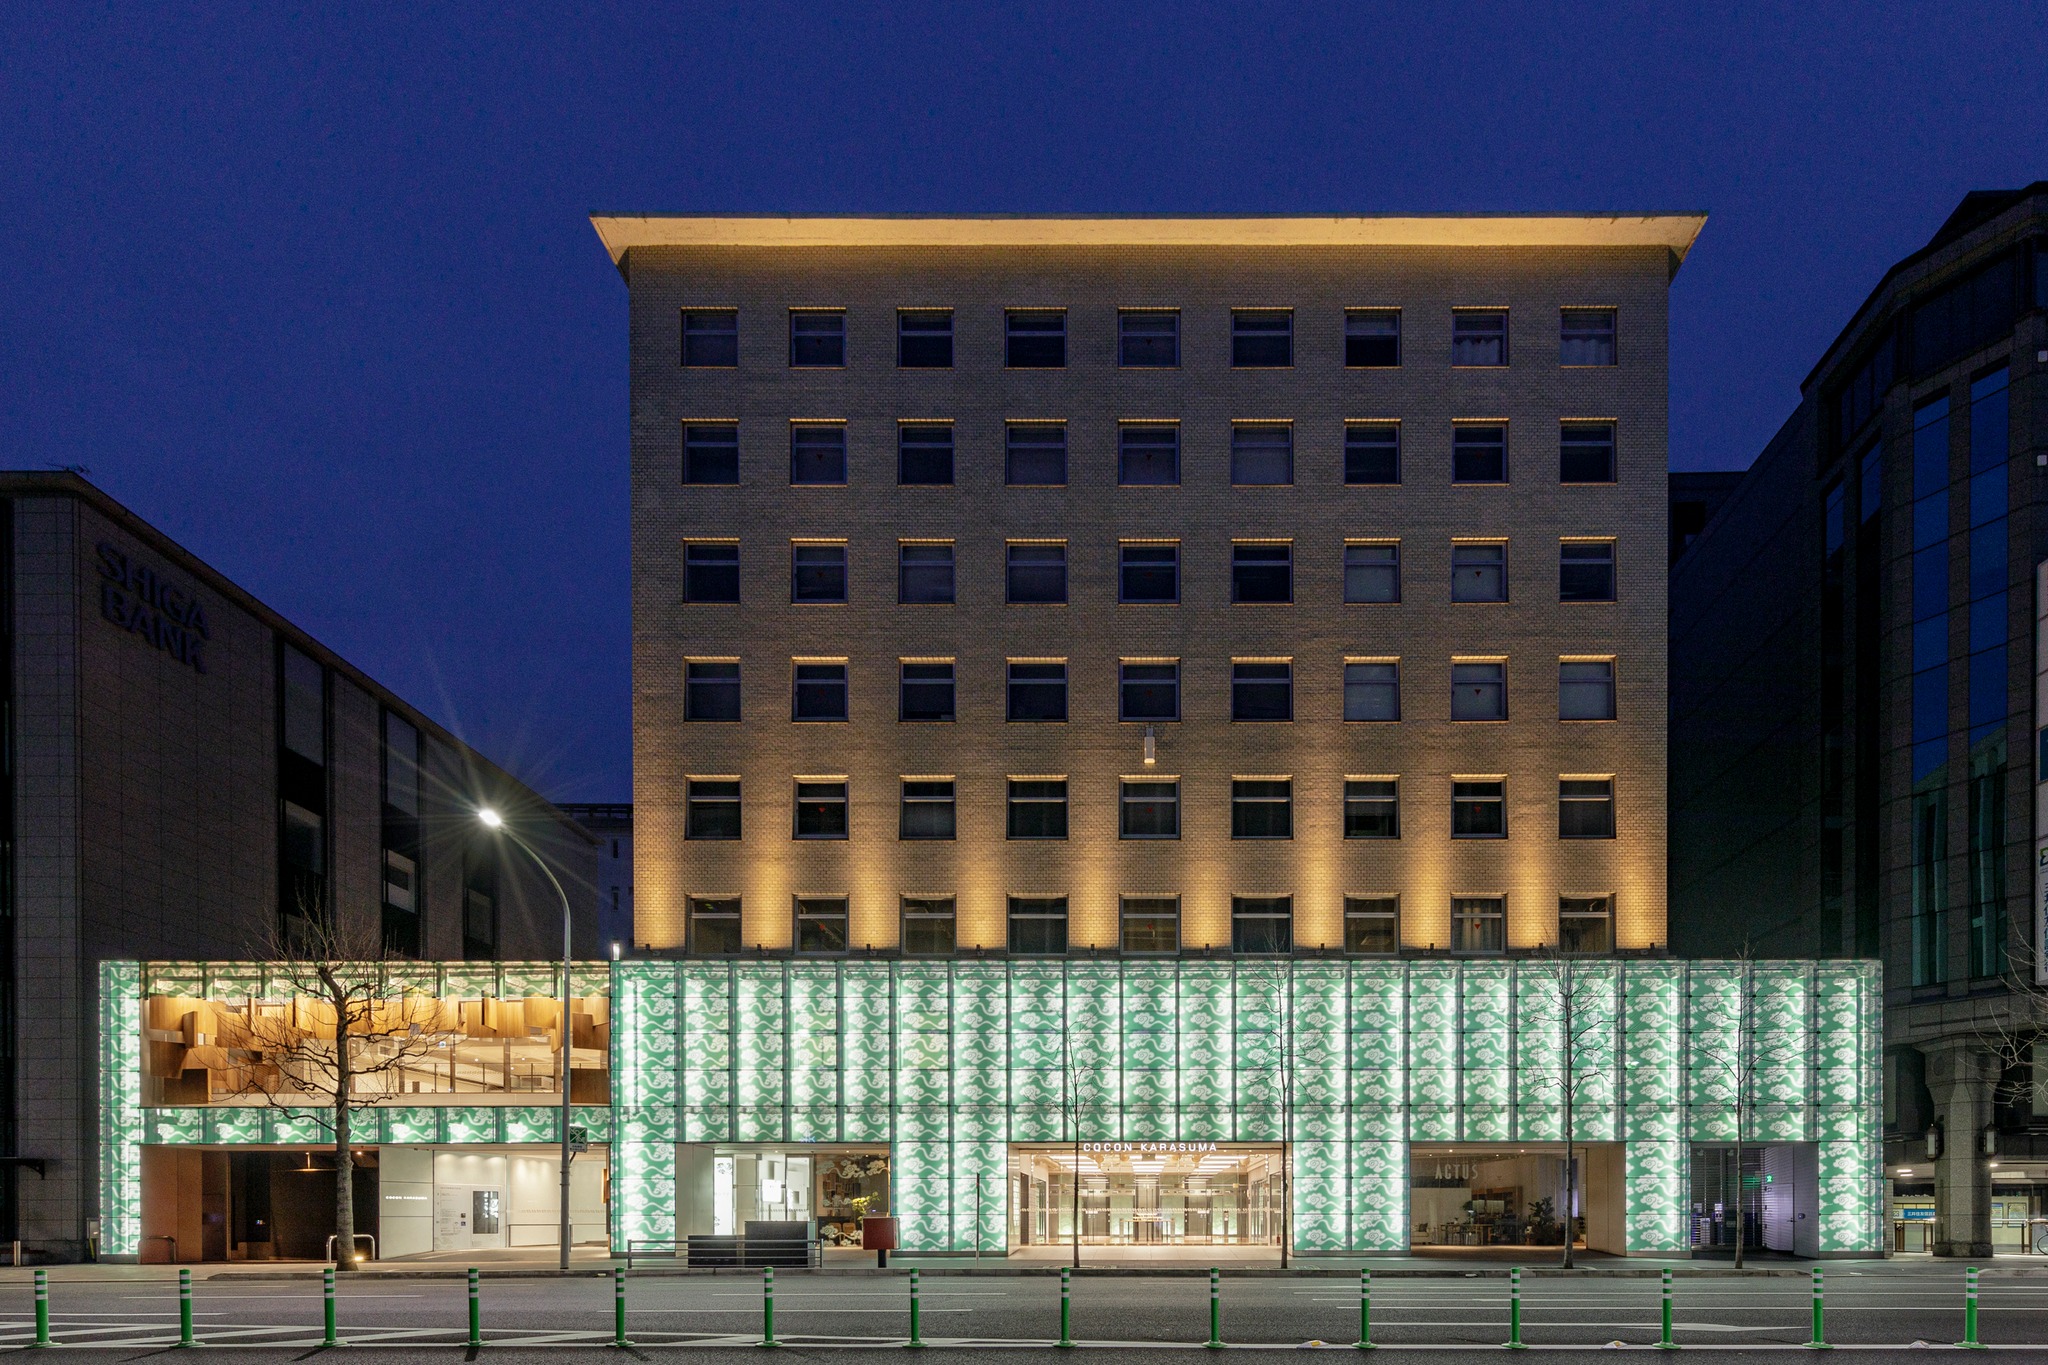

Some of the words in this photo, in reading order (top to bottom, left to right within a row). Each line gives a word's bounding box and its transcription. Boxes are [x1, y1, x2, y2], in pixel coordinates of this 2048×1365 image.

[95, 541, 209, 642] SHIGA
[101, 581, 207, 675] BANK
[1083, 1142, 1133, 1152] COCON
[1140, 1142, 1217, 1152] KARASUMA
[1435, 1163, 1479, 1180] ACTUS
